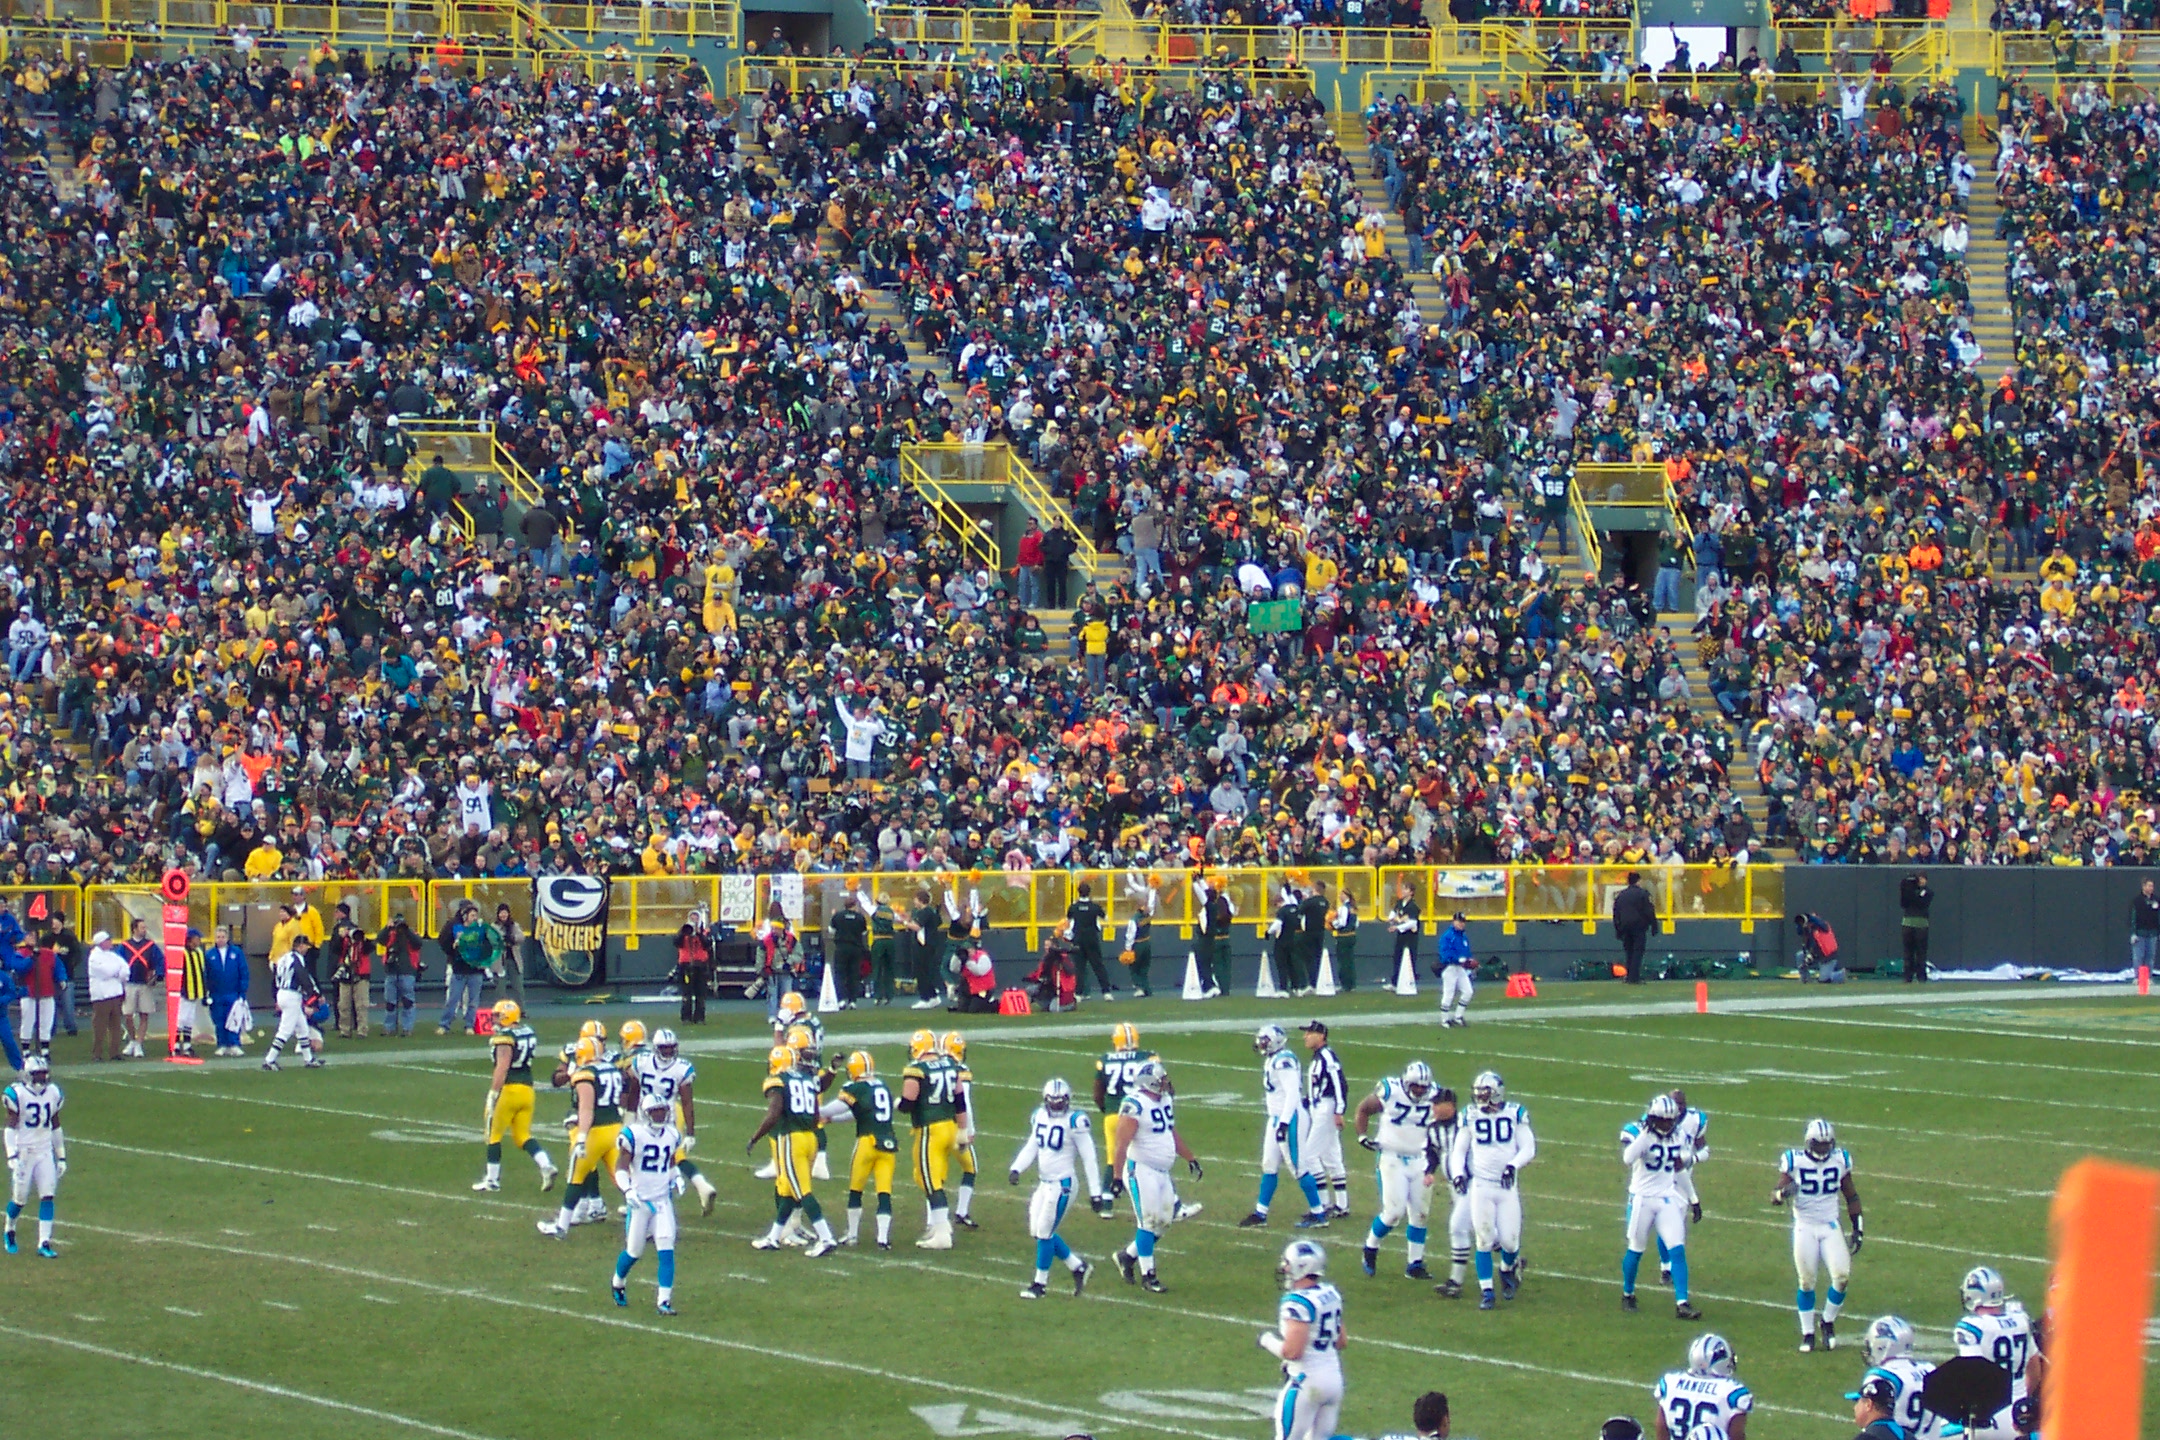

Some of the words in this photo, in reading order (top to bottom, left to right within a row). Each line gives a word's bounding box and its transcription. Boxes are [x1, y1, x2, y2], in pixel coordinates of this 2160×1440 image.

[991, 485, 1006, 494] 110
[723, 891, 754, 903] PACK
[724, 877, 741, 889] GO
[29, 893, 48, 920] 4
[733, 906, 751, 918] GO
[1010, 995, 1027, 1013] 10
[641, 1073, 675, 1101] 53
[1105, 1062, 1138, 1096] 79
[788, 1079, 816, 1114] 86
[874, 1087, 892, 1122] 9
[25, 1102, 52, 1129] 31
[1391, 1101, 1432, 1128] 77
[1035, 1122, 1064, 1151] 50
[1474, 1117, 1513, 1145] 90
[641, 1144, 672, 1173] 21
[1645, 1143, 1682, 1172] 35
[1800, 1166, 1839, 1195] 52
[1993, 1334, 2029, 1380] 87
[1675, 1378, 1718, 1397] MANUEL
